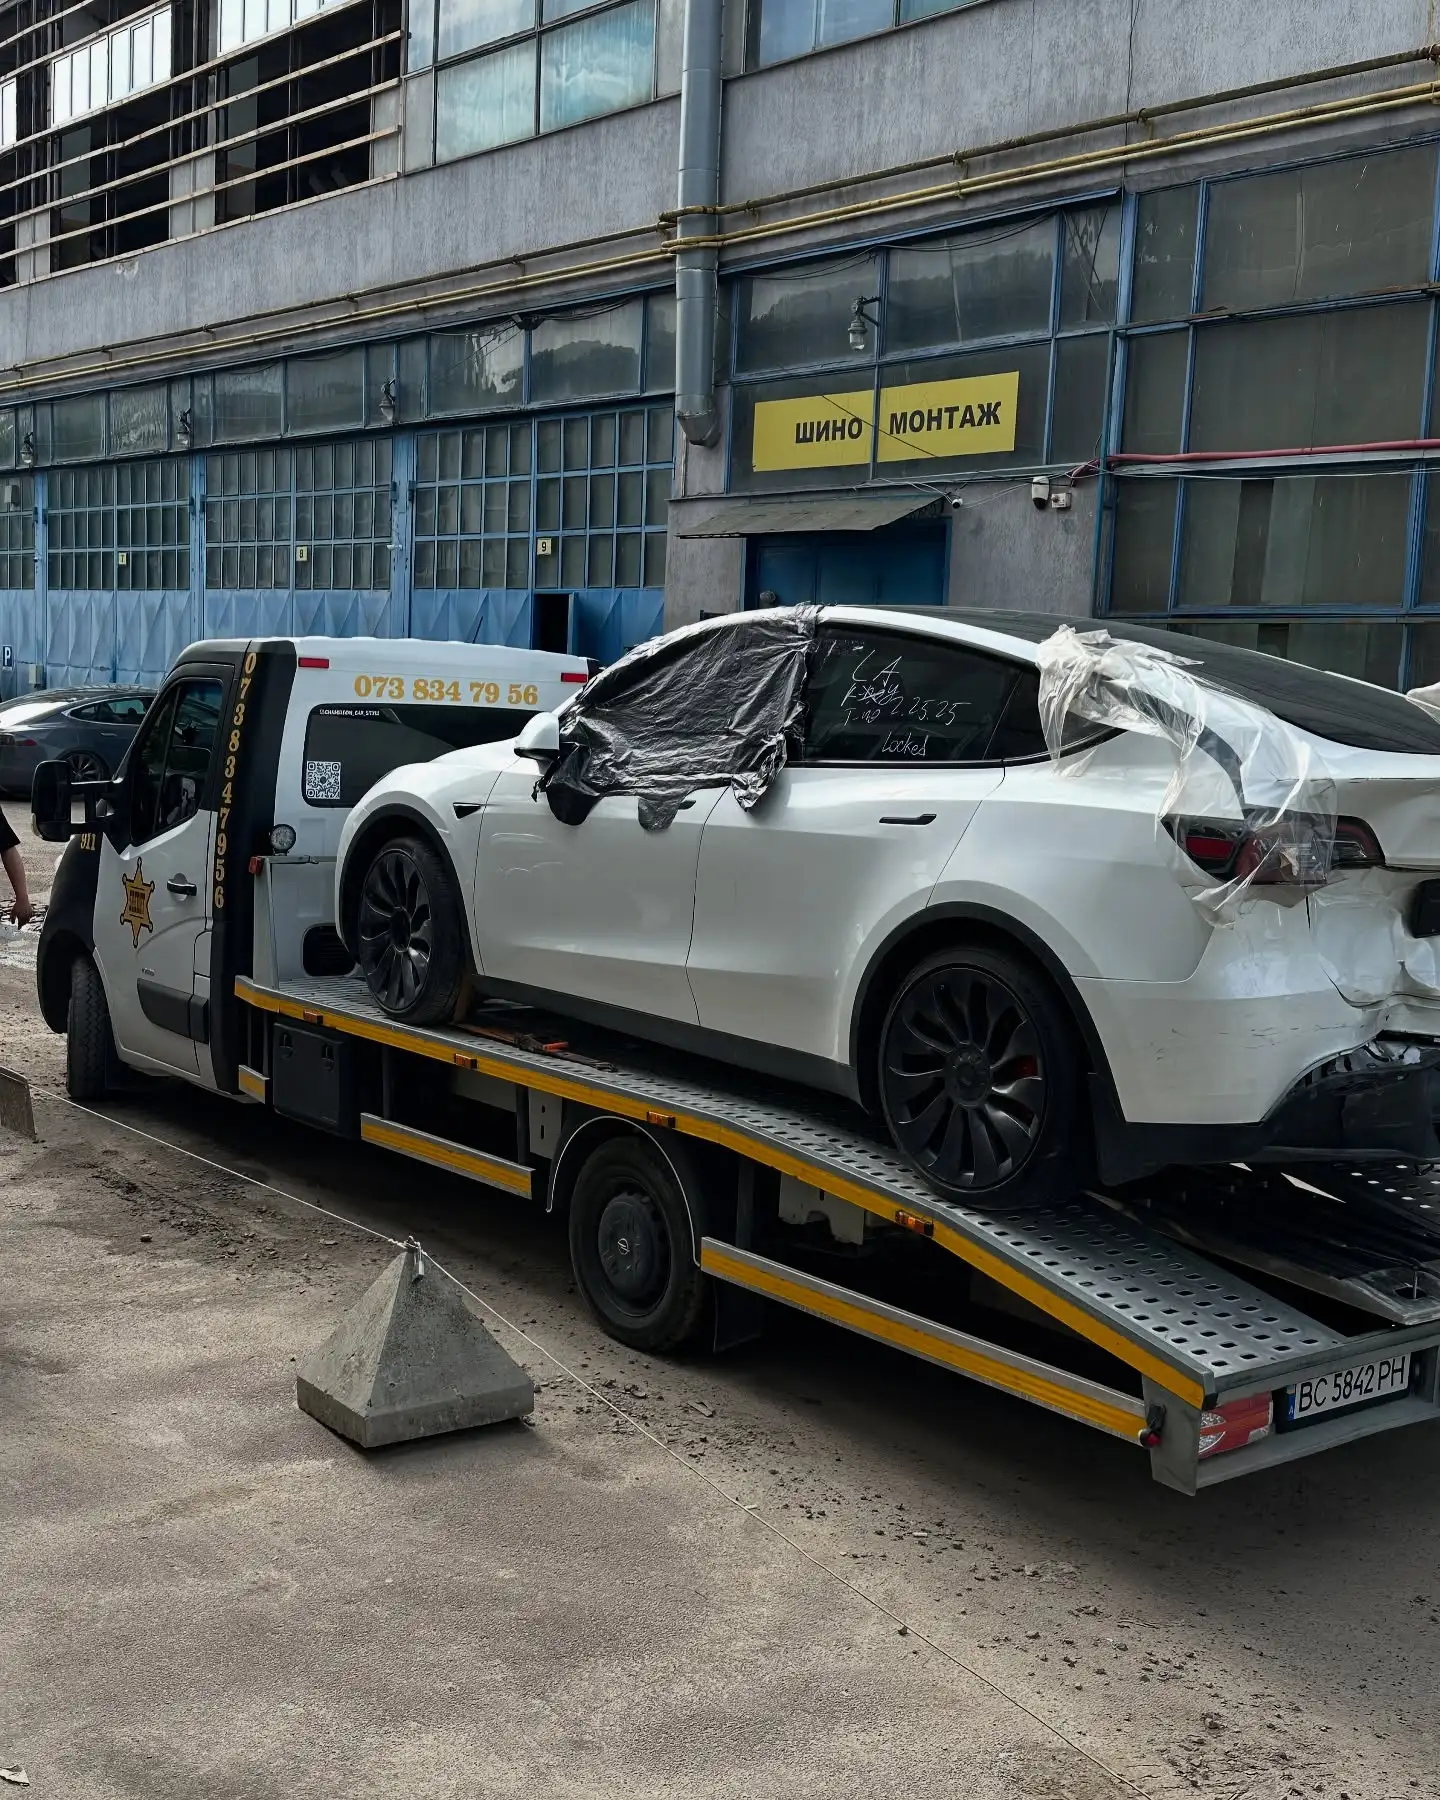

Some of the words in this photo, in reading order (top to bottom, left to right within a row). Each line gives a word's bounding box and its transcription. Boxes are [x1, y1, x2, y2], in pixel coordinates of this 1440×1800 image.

[795, 417, 863, 444] ШИНО
[889, 401, 1002, 435] МОНТАЖ
[354, 675, 405, 700] 073
[413, 679, 462, 702] 834
[469, 682, 500, 704] 79
[507, 684, 538, 705] 56
[80, 832, 96, 851] 911
[1299, 1378, 1328, 1413] BC
[1332, 1365, 1375, 1402] 5842
[1378, 1356, 1405, 1390] PH
